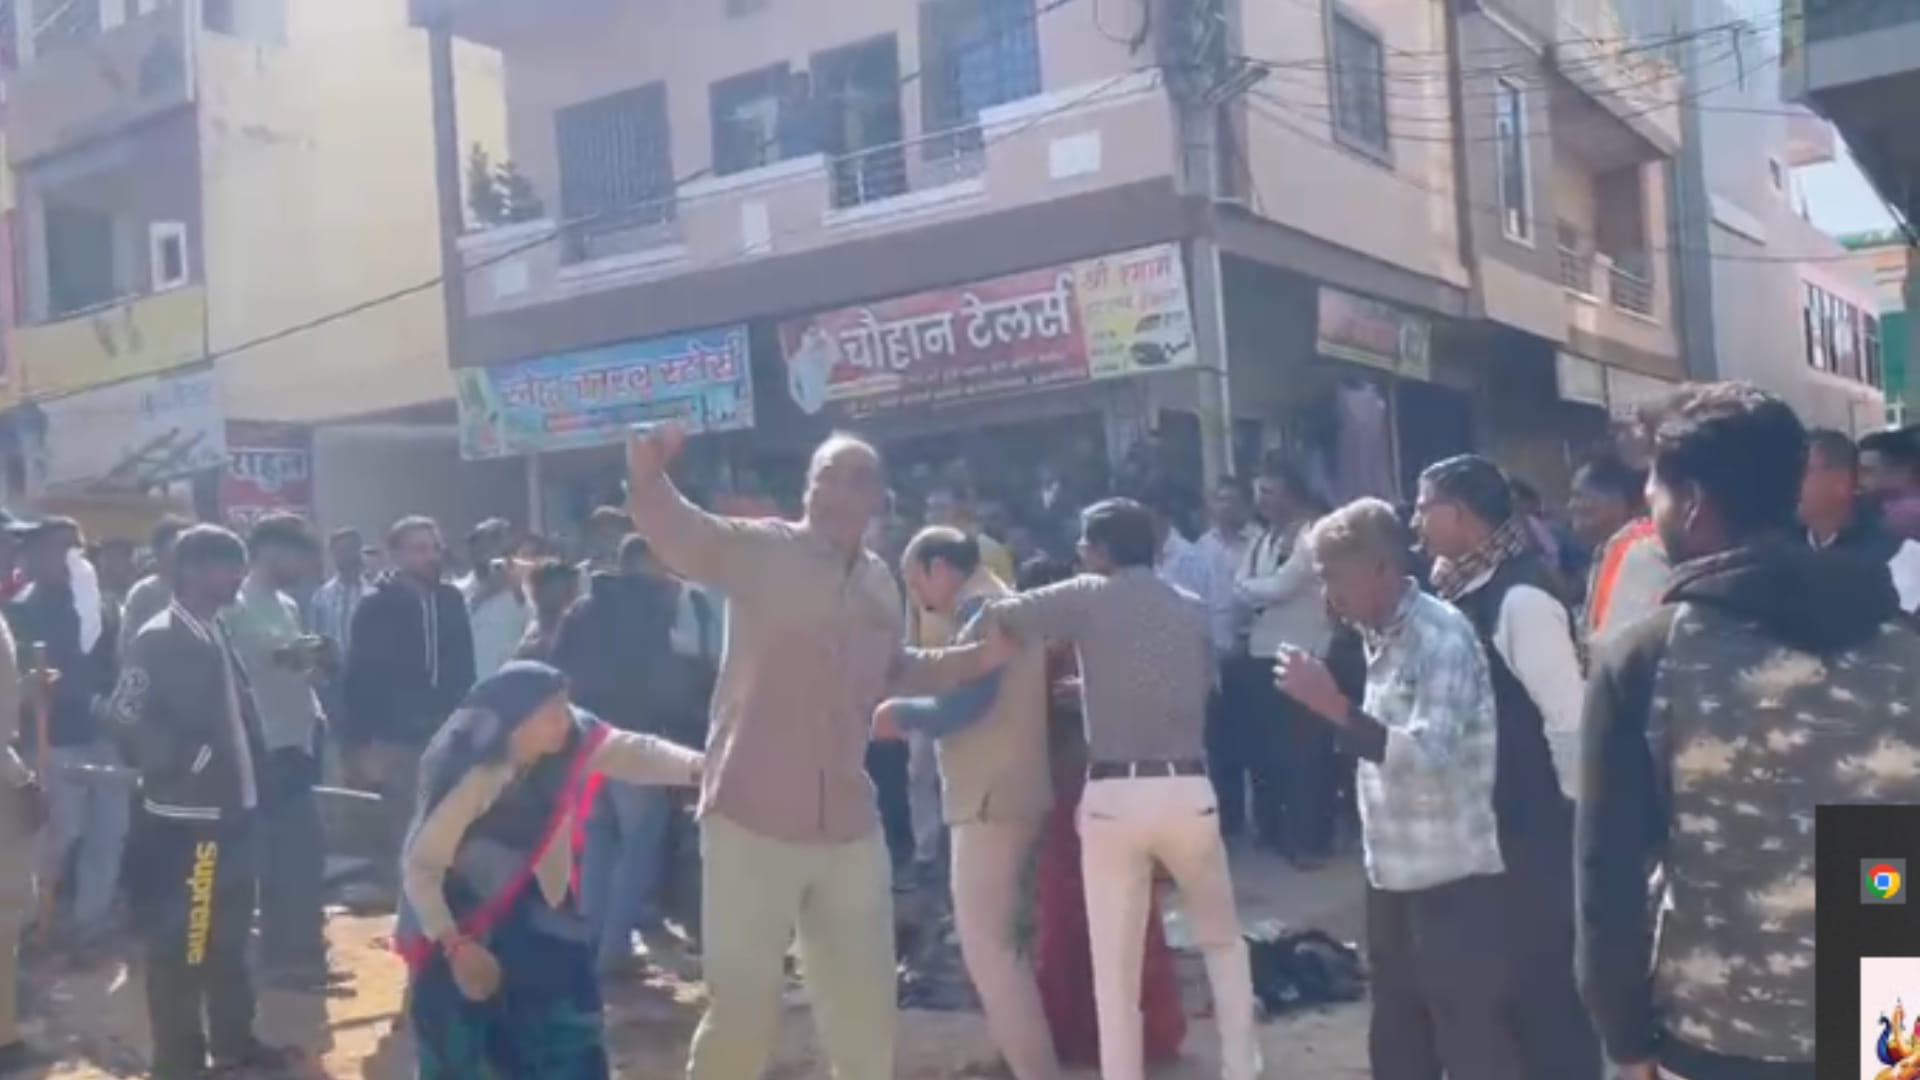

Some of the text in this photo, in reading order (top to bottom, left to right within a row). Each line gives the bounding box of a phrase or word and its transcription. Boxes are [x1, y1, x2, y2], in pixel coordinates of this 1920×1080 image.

[841, 306, 956, 371] चौहान
[960, 270, 1075, 349] टेलर्स
[227, 447, 308, 493] राहुल
[186, 841, 218, 965] Supreme
